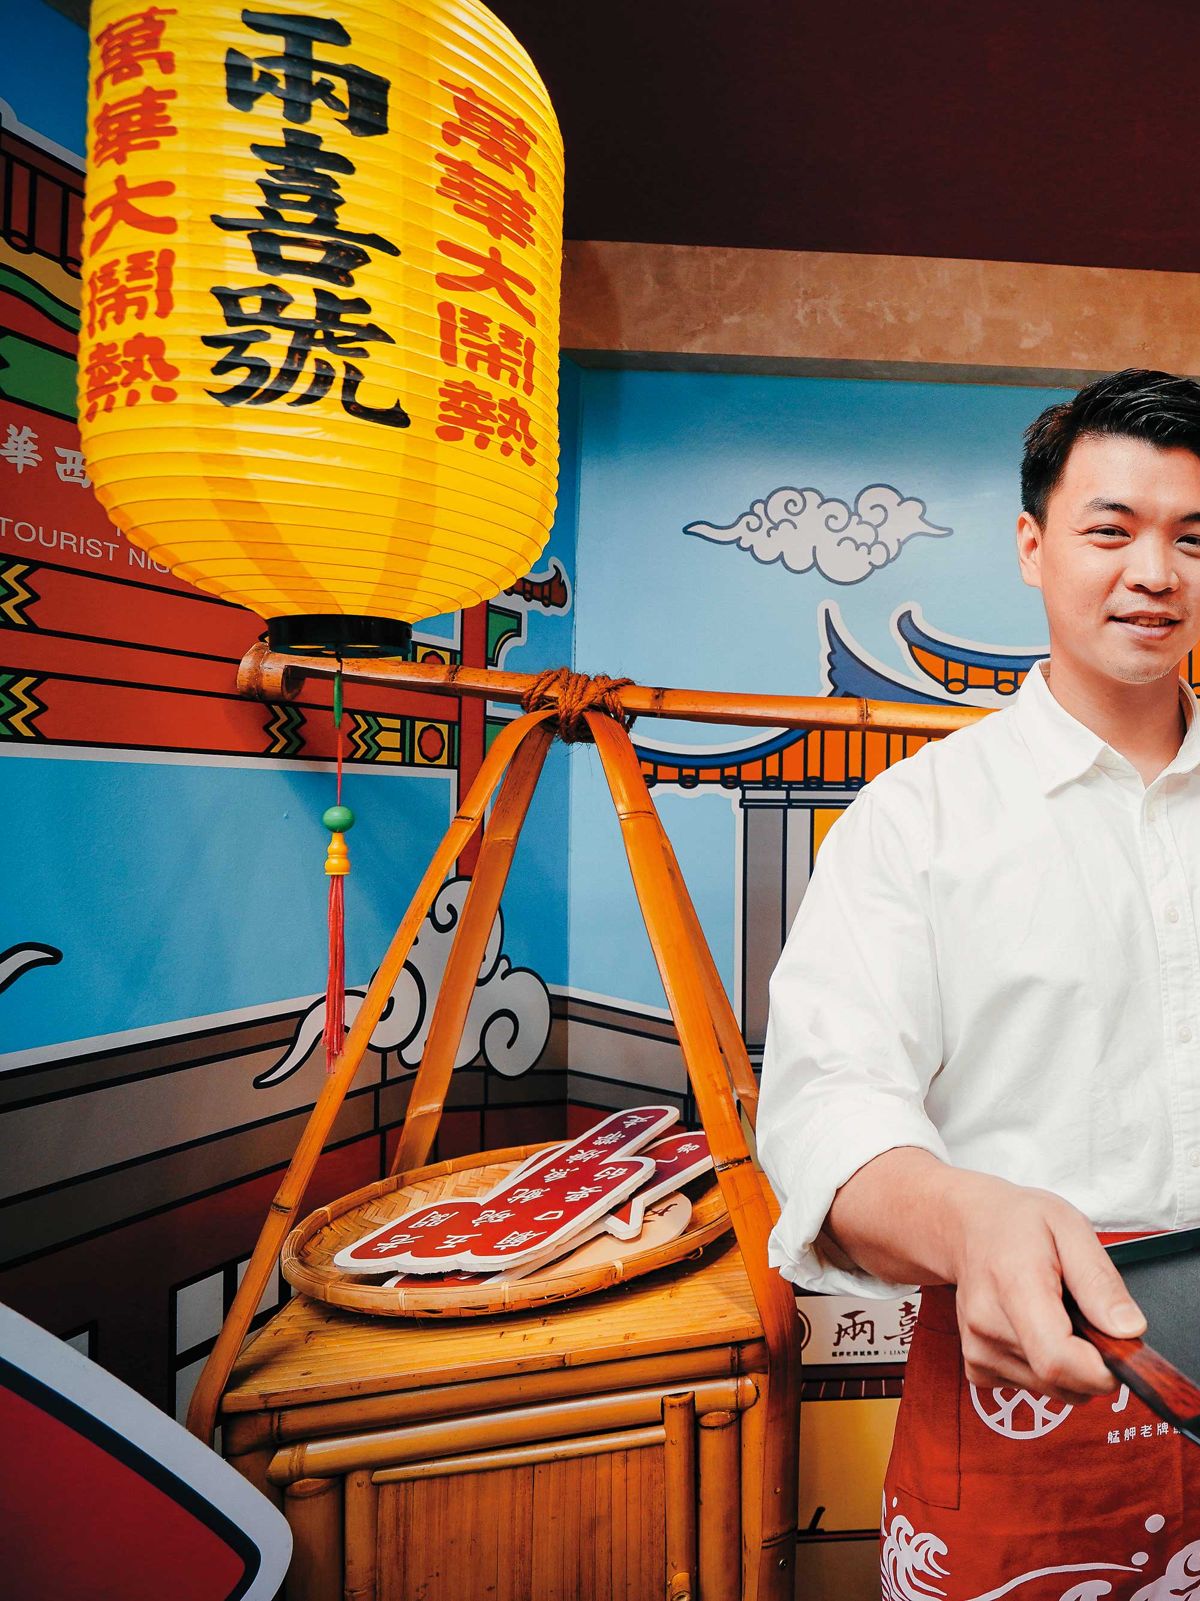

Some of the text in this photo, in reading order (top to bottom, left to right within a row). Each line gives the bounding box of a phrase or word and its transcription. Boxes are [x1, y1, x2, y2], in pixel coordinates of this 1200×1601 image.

[434, 78, 538, 468] 萬華大鬧熱
